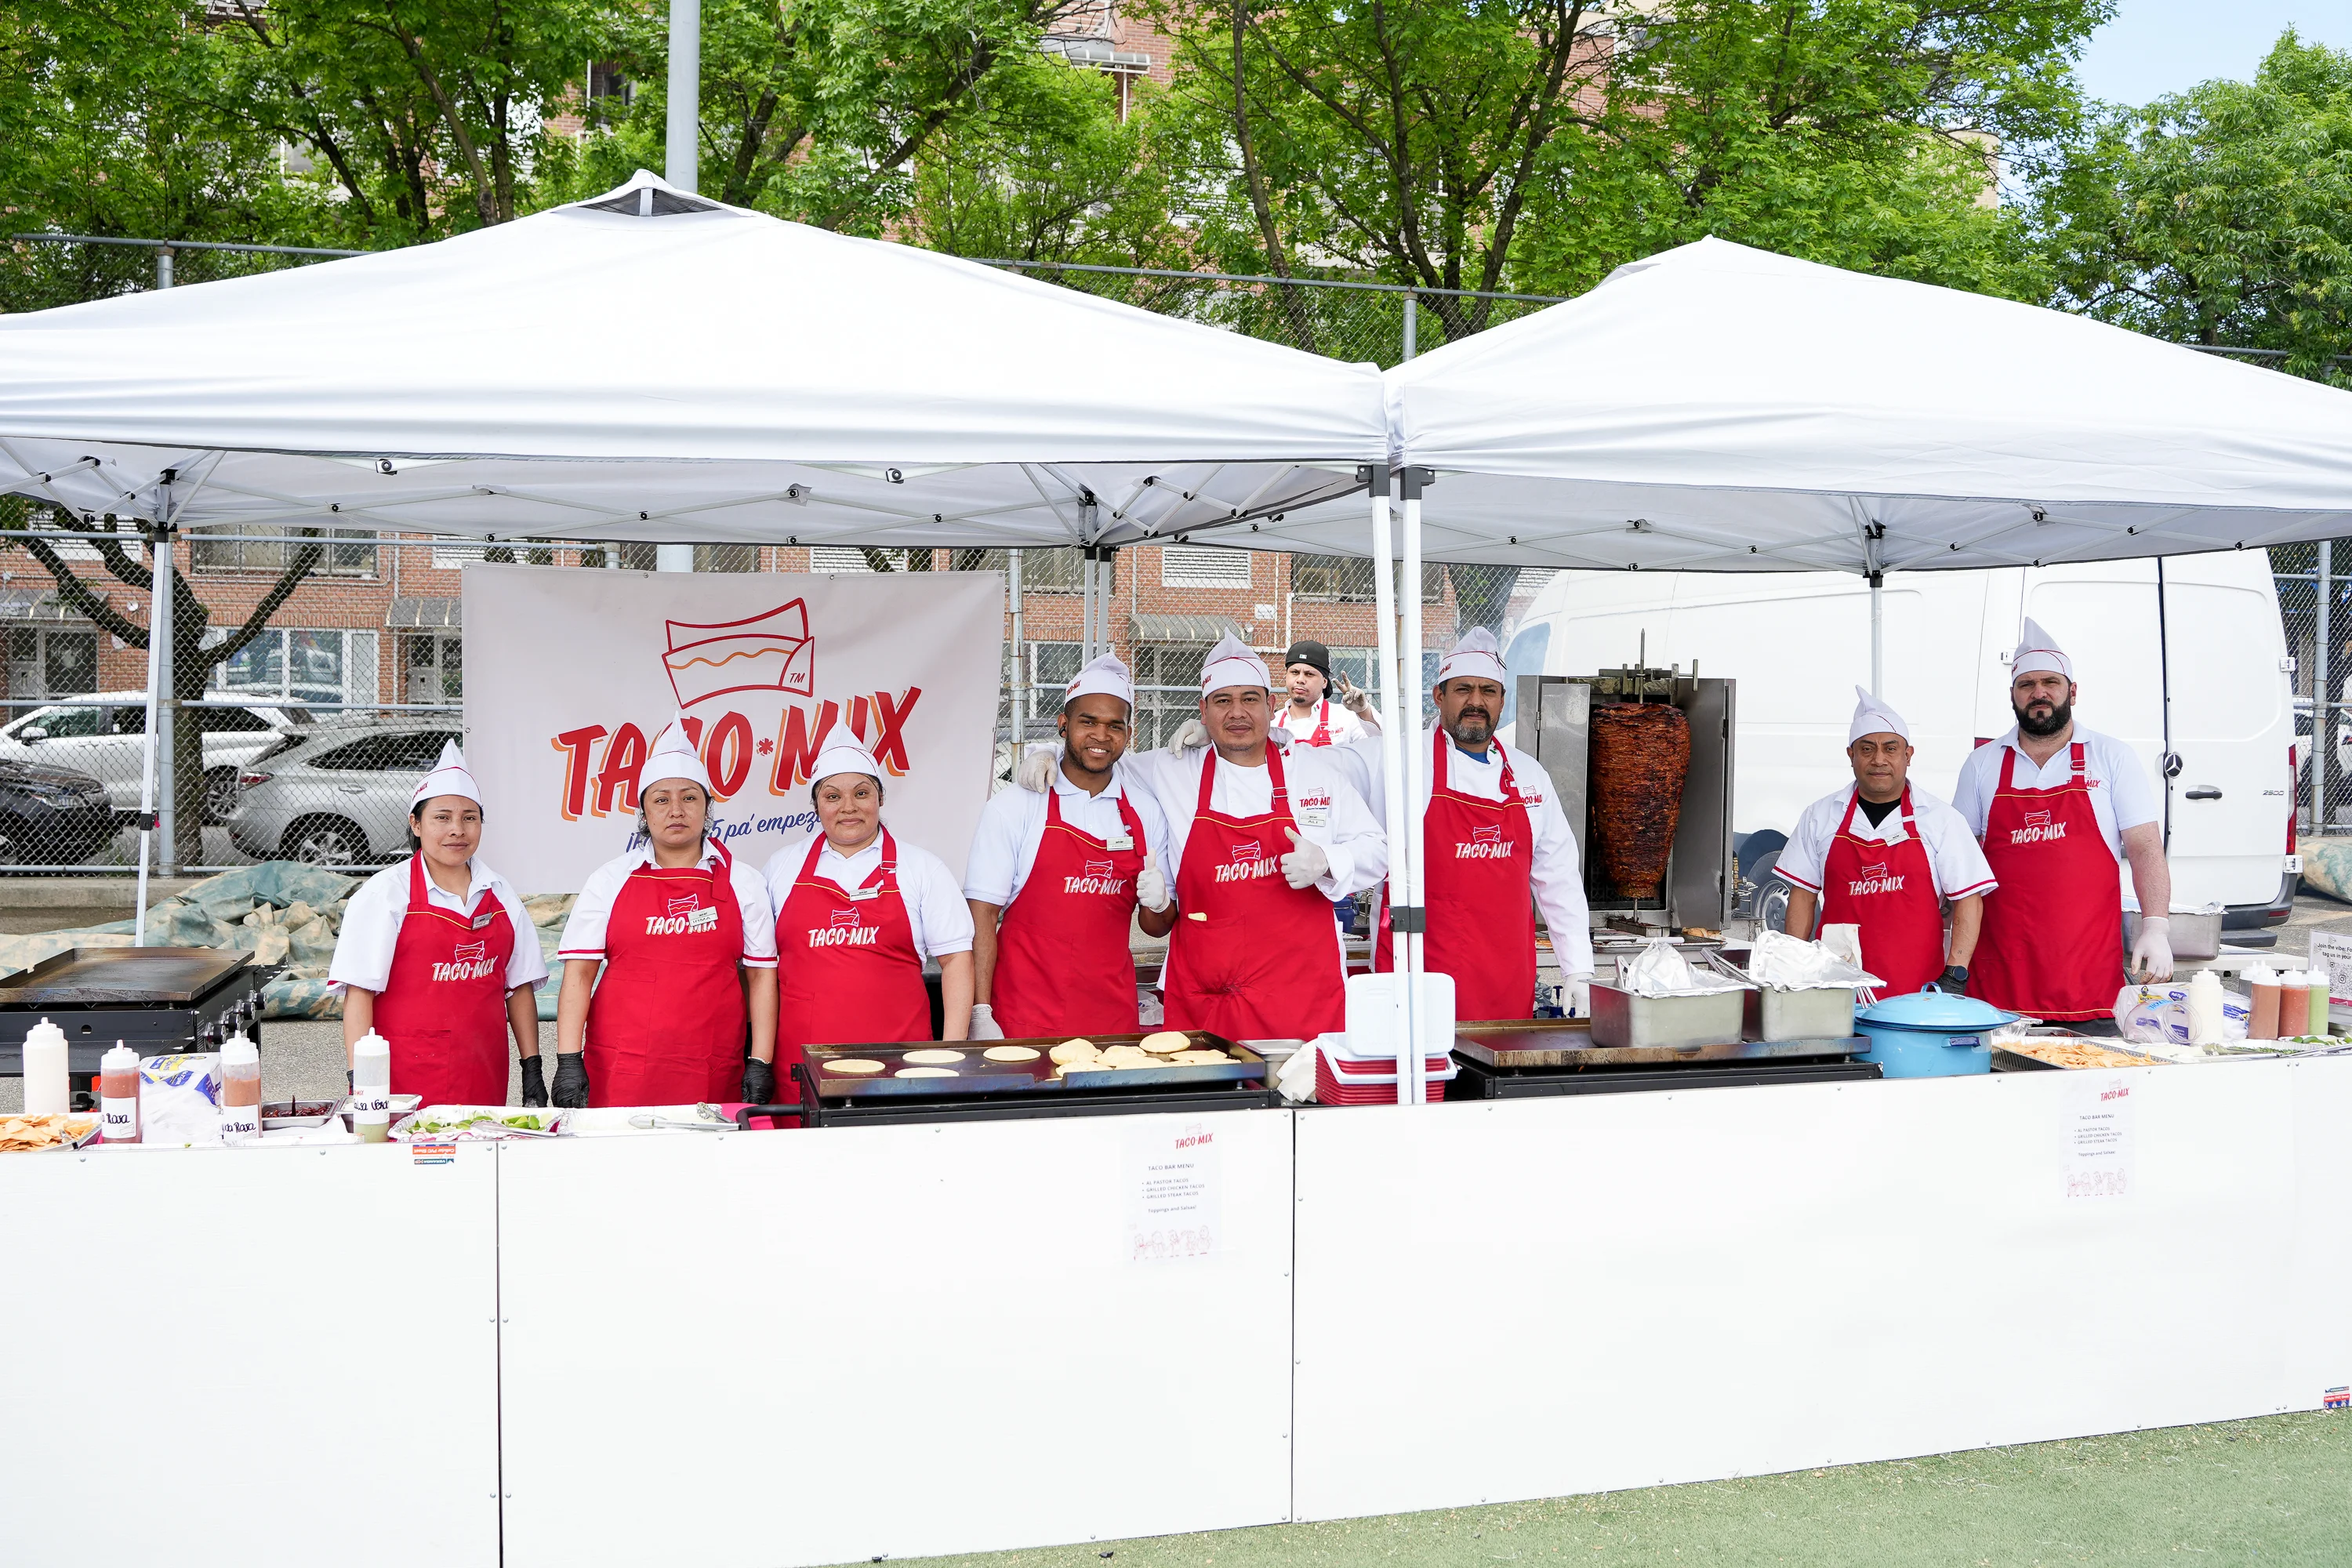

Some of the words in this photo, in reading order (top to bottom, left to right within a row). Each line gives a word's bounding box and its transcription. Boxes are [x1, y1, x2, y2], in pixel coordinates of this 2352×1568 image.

[789, 673, 805, 683] TM
[354, 1099, 368, 1111] alsa
[371, 1099, 389, 1110] Verd
